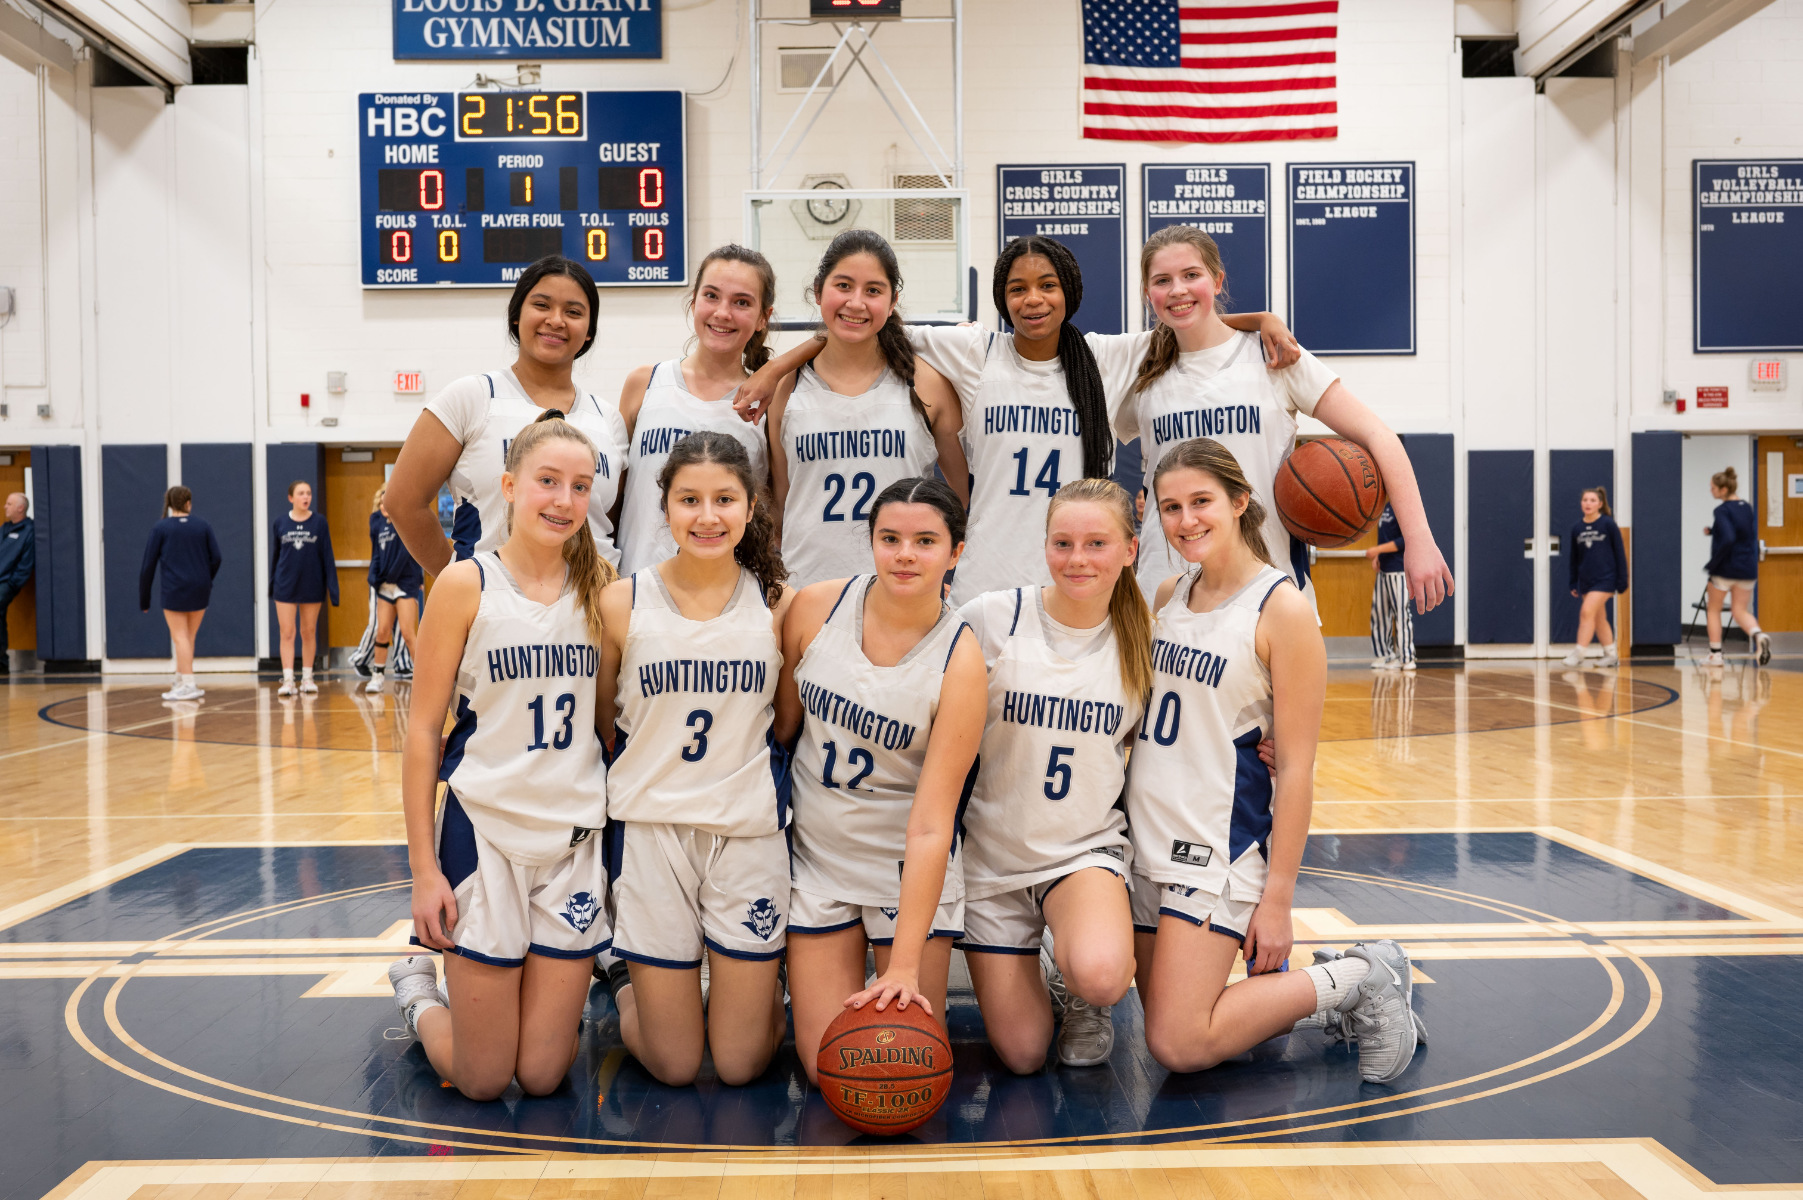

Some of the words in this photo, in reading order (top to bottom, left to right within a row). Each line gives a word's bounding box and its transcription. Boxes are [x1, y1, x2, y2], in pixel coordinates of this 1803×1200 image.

[423, 17, 631, 48] GYMNASIUM
[375, 94, 421, 105] Donated
[423, 94, 439, 106] By
[367, 107, 447, 137] HBC
[463, 95, 580, 135] 21:56
[385, 144, 440, 164] HOME
[498, 155, 544, 168] PERIOD
[599, 143, 661, 162] GUEST
[1041, 170, 1083, 185] GIRLS
[1185, 169, 1228, 183] GIRLS
[1299, 169, 1342, 184] FIELD
[1345, 169, 1403, 184] HOCKEY
[1737, 166, 1779, 178] GIRLS
[420, 169, 443, 210] 0
[525, 175, 533, 203] 1
[639, 168, 663, 208] 0
[1005, 186, 1051, 200] CROSS
[1053, 186, 1118, 200] COUNTRY
[1174, 184, 1235, 199] FENCING
[1297, 184, 1406, 200] CHAMPIONSHIP
[1712, 178, 1803, 191] VOLLEYBALL
[1003, 201, 1121, 216] CHAMPIONSHIPS
[1148, 200, 1266, 215] CHAMPIONSHIPS
[1324, 206, 1378, 219] LEAGUE
[375, 214, 417, 229] FOULS
[431, 214, 467, 228] T.O.L.
[481, 213, 530, 227] PLAYER
[532, 213, 565, 227] FOUL
[579, 212, 615, 227] T.O.L.
[628, 212, 670, 226] FOULS
[1731, 211, 1785, 224] LEAGUE
[1036, 223, 1089, 235] LEAGUE
[392, 231, 411, 262] 0
[439, 230, 459, 262] 0
[587, 229, 607, 260] 0
[644, 228, 663, 259] 0
[376, 268, 419, 283] SCORE
[628, 266, 669, 280] SCORE
[1757, 362, 1781, 380] EXIT
[397, 373, 420, 391] EXIT
[985, 404, 1081, 437] HUNTINGTO
[1153, 404, 1260, 445] HUNTINGTON
[796, 429, 905, 463] HUNTINGTON
[1009, 446, 1061, 498] 14
[822, 471, 877, 523] 22
[639, 660, 766, 698] HUNTINGTON
[527, 693, 576, 752] 13
[801, 680, 917, 751] HUNTINGTON
[1138, 687, 1182, 747] 10
[681, 709, 714, 762] 3
[821, 740, 874, 793] 12
[1043, 746, 1075, 801] 5
[1192, 855, 1201, 863] M
[838, 1045, 935, 1071] SPALDING
[840, 1086, 932, 1109] TF-1000
[861, 1106, 896, 1114] CLASSIC
